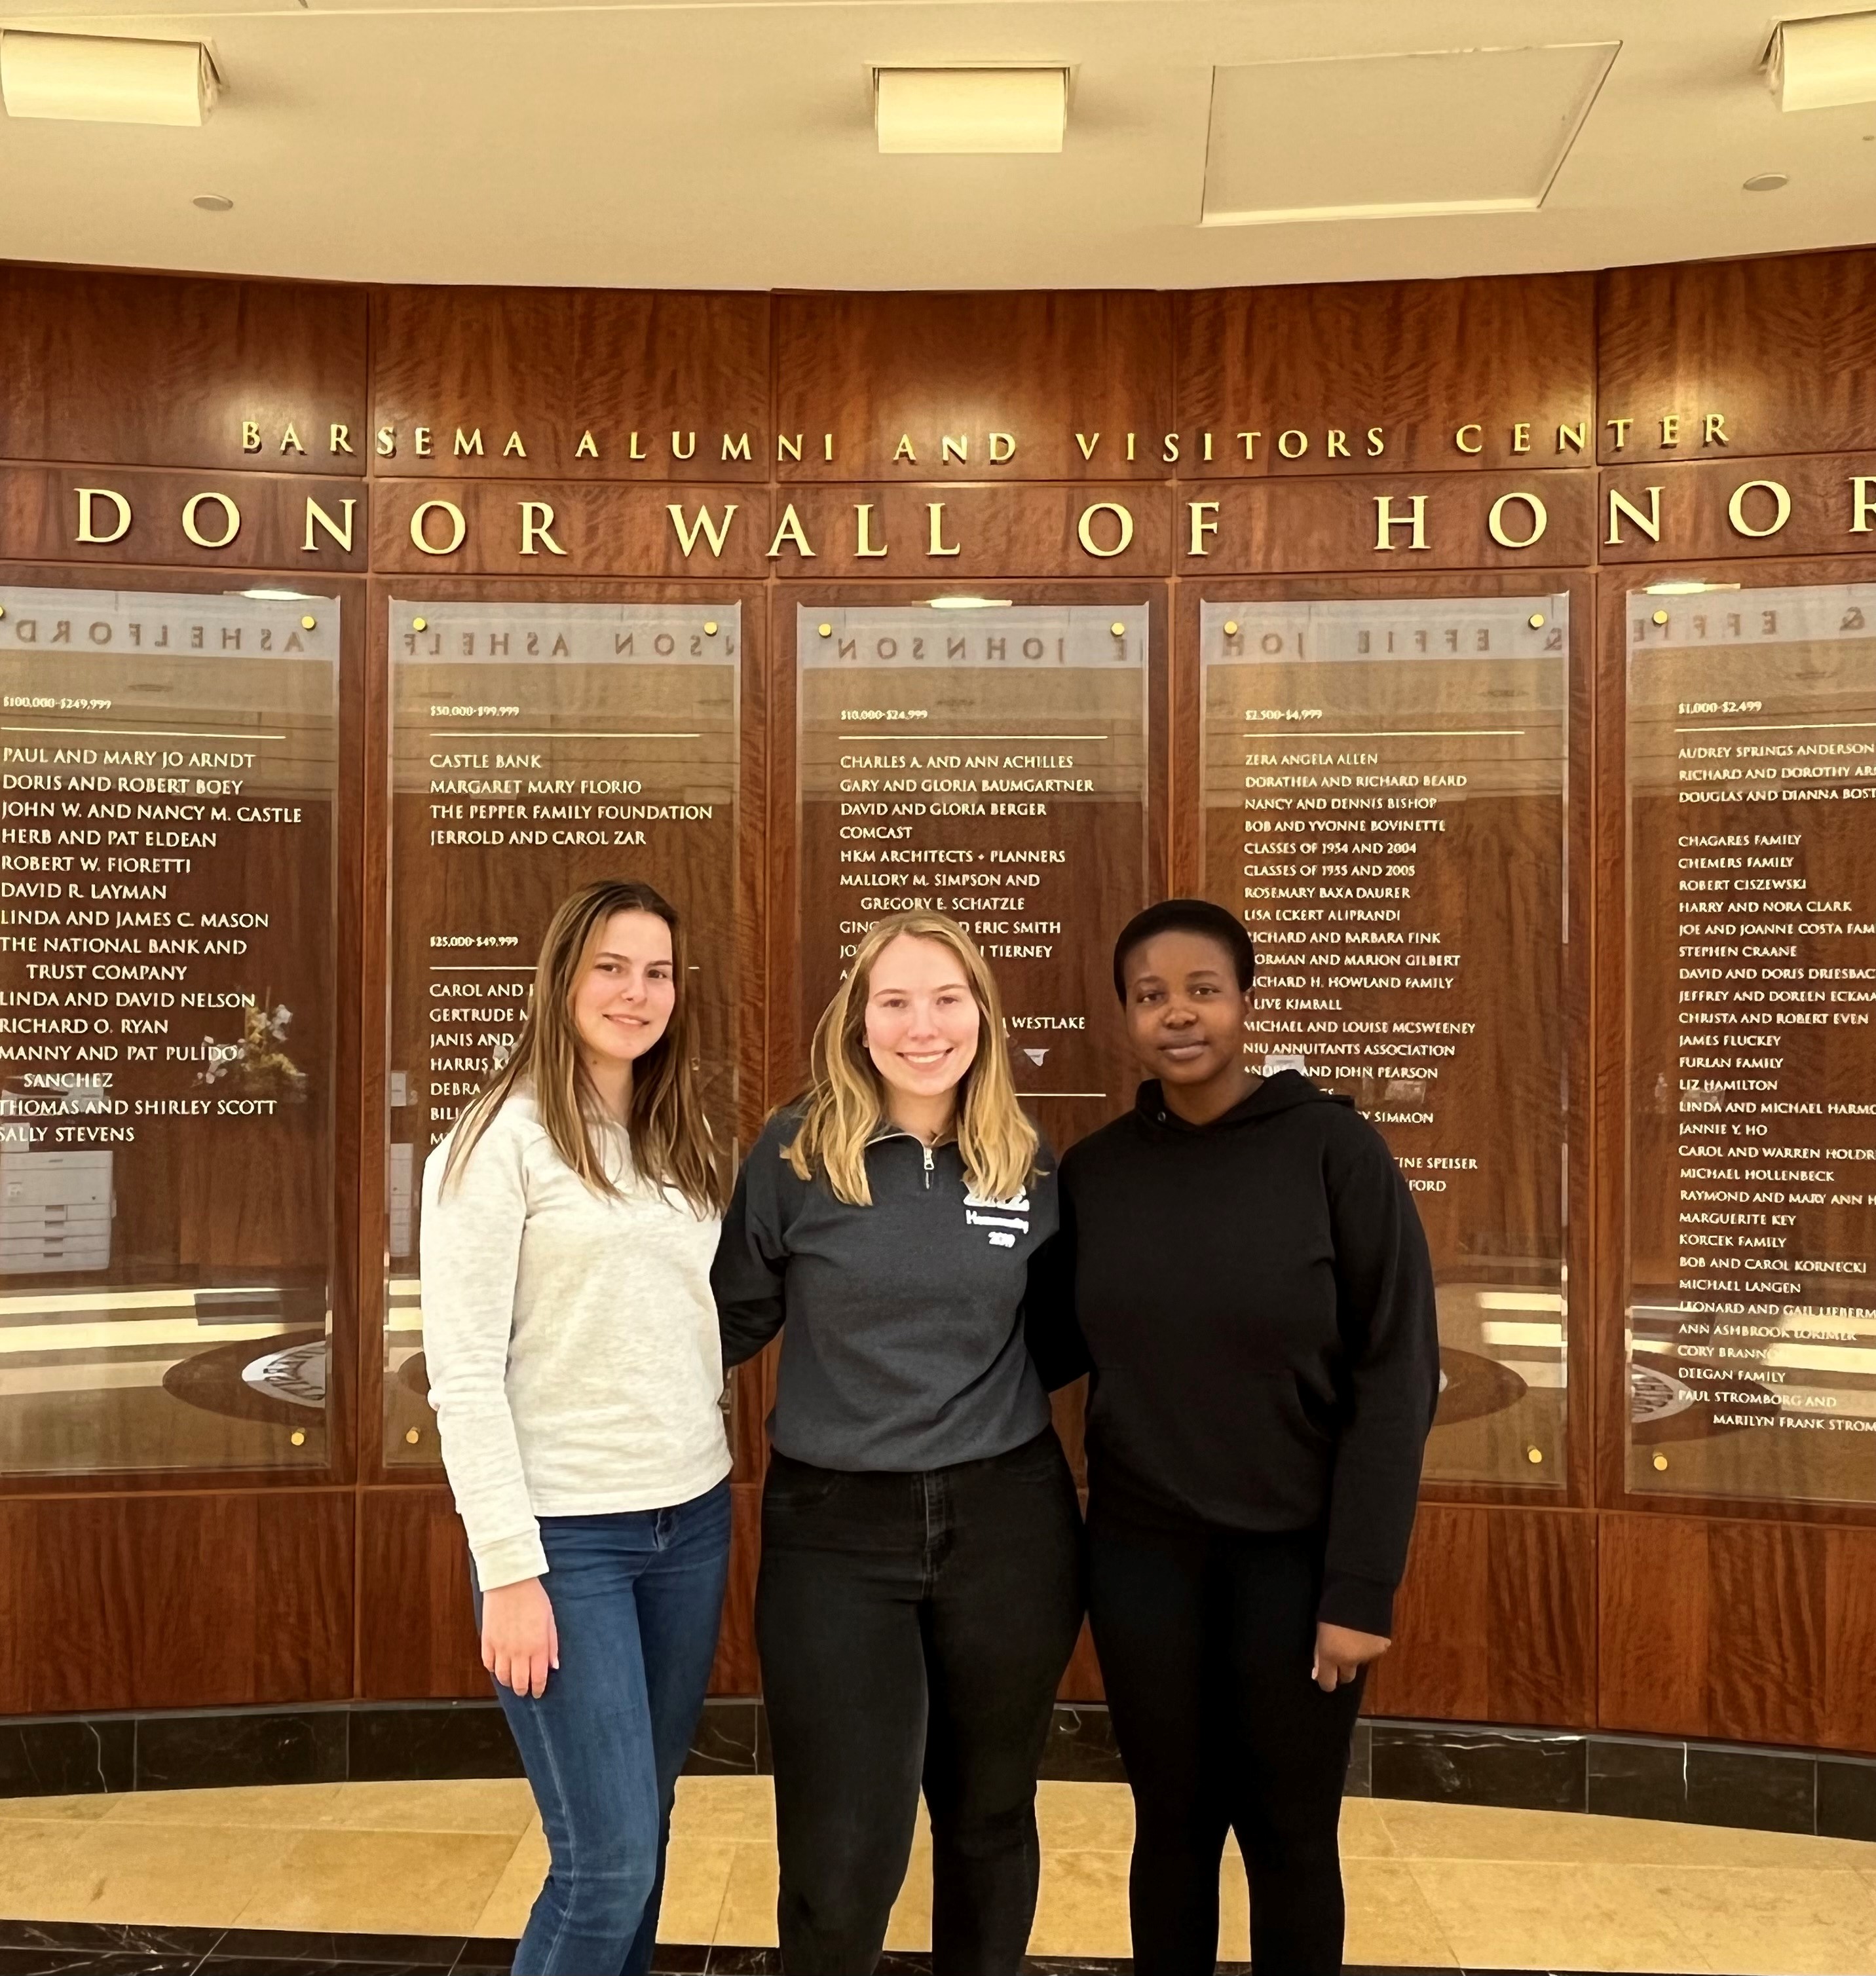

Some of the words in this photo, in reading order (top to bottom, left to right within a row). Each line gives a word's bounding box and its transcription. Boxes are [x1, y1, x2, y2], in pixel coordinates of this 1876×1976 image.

[242, 420, 527, 457] BARSEMA
[574, 430, 832, 462] ALUMNI
[893, 431, 1016, 462] AND
[1075, 427, 1384, 462] VISITORS
[1456, 413, 1730, 453] CENTER
[74, 487, 567, 555] DONOR
[666, 502, 961, 558] WALL
[1078, 501, 1220, 557] OF
[3, 747, 48, 763] PAUL
[53, 749, 98, 764] AND
[103, 750, 157, 766] MARY
[188, 753, 256, 768] ARNDT
[1678, 747, 1732, 759] AUDREY
[1736, 745, 1793, 758] SPRINGS
[1797, 743, 1875, 756] ANDERSON
[429, 754, 490, 768] CASTLE
[495, 754, 542, 768] BANK
[840, 755, 906, 769] CHARLES
[926, 755, 962, 769] AND
[964, 755, 999, 768] ANN
[1002, 755, 1074, 768] ACHILLES
[1245, 754, 1278, 766] ZERA
[1281, 753, 1334, 766] ANGELA
[1336, 753, 1378, 766] ALLEN
[3, 774, 62, 791] DORIS
[67, 776, 112, 792] AND
[118, 777, 191, 796] ROBERT
[196, 779, 244, 795] BOEY
[430, 779, 523, 795] MARGARET
[528, 780, 576, 794] MARY
[580, 780, 642, 794] FLORIO
[840, 779, 880, 792] GARY
[882, 779, 917, 792] AND
[921, 779, 978, 792] GLORIA
[981, 779, 1095, 792] BAUMGARTNER
[840, 802, 888, 816] DAVID
[891, 803, 927, 816] AND
[929, 802, 986, 816] GLORIA
[990, 803, 1047, 816] BERGER
[1245, 798, 1293, 810] NANCY
[1296, 798, 1327, 810] AND
[1330, 797, 1383, 810] DENNIS
[1387, 797, 1437, 810] BISHOP
[1, 800, 55, 820] JOHN
[87, 804, 132, 819] AND
[137, 804, 206, 821] NANCY
[236, 806, 301, 823] CASTLE
[429, 804, 463, 819] THE
[470, 805, 529, 819] PEPPER
[533, 805, 593, 819] FAMILY
[597, 805, 712, 820] FOUNDATION
[839, 826, 913, 839] COMCAST
[1245, 820, 1271, 832] BOB
[1274, 820, 1305, 832] AND
[1308, 819, 1366, 832] YVONNE
[1370, 819, 1446, 832] BOVINETTE
[1, 828, 52, 845] HERB
[58, 830, 102, 845] AND
[107, 830, 140, 846] PAT
[145, 831, 217, 848] ELDEAN
[430, 830, 504, 846] JERROLD
[508, 830, 548, 845] AND
[552, 830, 609, 846] CAROL
[614, 830, 647, 845] ZAR
[1678, 834, 1750, 848] CHAGARES
[1754, 834, 1802, 846] FAMILY
[840, 849, 876, 863] HKM
[880, 849, 973, 863] ARCHITECTS
[990, 850, 1066, 863] PLANNERS
[1, 855, 75, 872] ROBERT
[107, 857, 191, 874] FIORETTI
[840, 874, 909, 887] MALLORY
[934, 873, 1001, 887] SIMPSON
[1005, 874, 1040, 887] AND
[1, 882, 62, 899] DAVID
[91, 884, 166, 900] LAYMAN
[861, 897, 932, 910] GREGORY
[952, 897, 1025, 910] SCHATZLE
[1679, 901, 1724, 913] HARRY
[1727, 901, 1759, 913] AND
[1763, 901, 1803, 912] NORA
[1806, 901, 1852, 912] CLARK
[1, 910, 61, 925] LINDA
[66, 910, 110, 926] AND
[115, 911, 171, 929] JAMES
[200, 913, 269, 928] MASON
[975, 921, 1009, 934] ERIC
[1013, 921, 1061, 935] SMITH
[0, 937, 37, 952] THE
[43, 937, 142, 954] NATIONAL
[149, 939, 200, 954] BANK
[203, 939, 248, 955] AND
[988, 944, 1053, 958] TIERNEY
[26, 963, 87, 980] TRUST
[92, 964, 187, 981] COMPANY
[429, 983, 483, 997] CAROL
[487, 983, 524, 997] AND
[0, 991, 60, 1007] LINDA
[64, 992, 109, 1007] AND
[116, 992, 175, 1008] DAVID
[181, 992, 255, 1008] NELSON
[429, 1007, 514, 1022] GERTRUDE
[0, 1018, 88, 1034] RICHARD
[121, 1018, 168, 1034] RYAN
[1011, 1016, 1085, 1030] WESTLAKE
[430, 1033, 474, 1049] JANIS
[477, 1033, 516, 1047] AND
[0, 1046, 70, 1061] MANNY
[75, 1045, 119, 1061] AND
[127, 1045, 159, 1061] PAT
[1243, 1042, 1269, 1054] NIU
[1272, 1043, 1360, 1055] ANNUITANTS
[1363, 1044, 1455, 1056] ASSOCIATION
[430, 1057, 489, 1072] HARRIS
[24, 1072, 113, 1088] SANCHEZ
[1679, 1079, 1700, 1091] LIZ
[1704, 1079, 1778, 1091] HAMILTON
[430, 1082, 481, 1096] DEBRA
[0, 1100, 79, 1117] THOMAS
[84, 1099, 129, 1115] AND
[134, 1100, 212, 1115] SHIRLEY
[217, 1099, 278, 1115] SCOTT
[1374, 1111, 1434, 1124] SIMMON
[0, 1126, 48, 1142] SALLY
[55, 1127, 135, 1142] STEVENS
[1679, 1168, 1740, 1180] MICHAEL
[1744, 1169, 1835, 1182] HOLLENBECK
